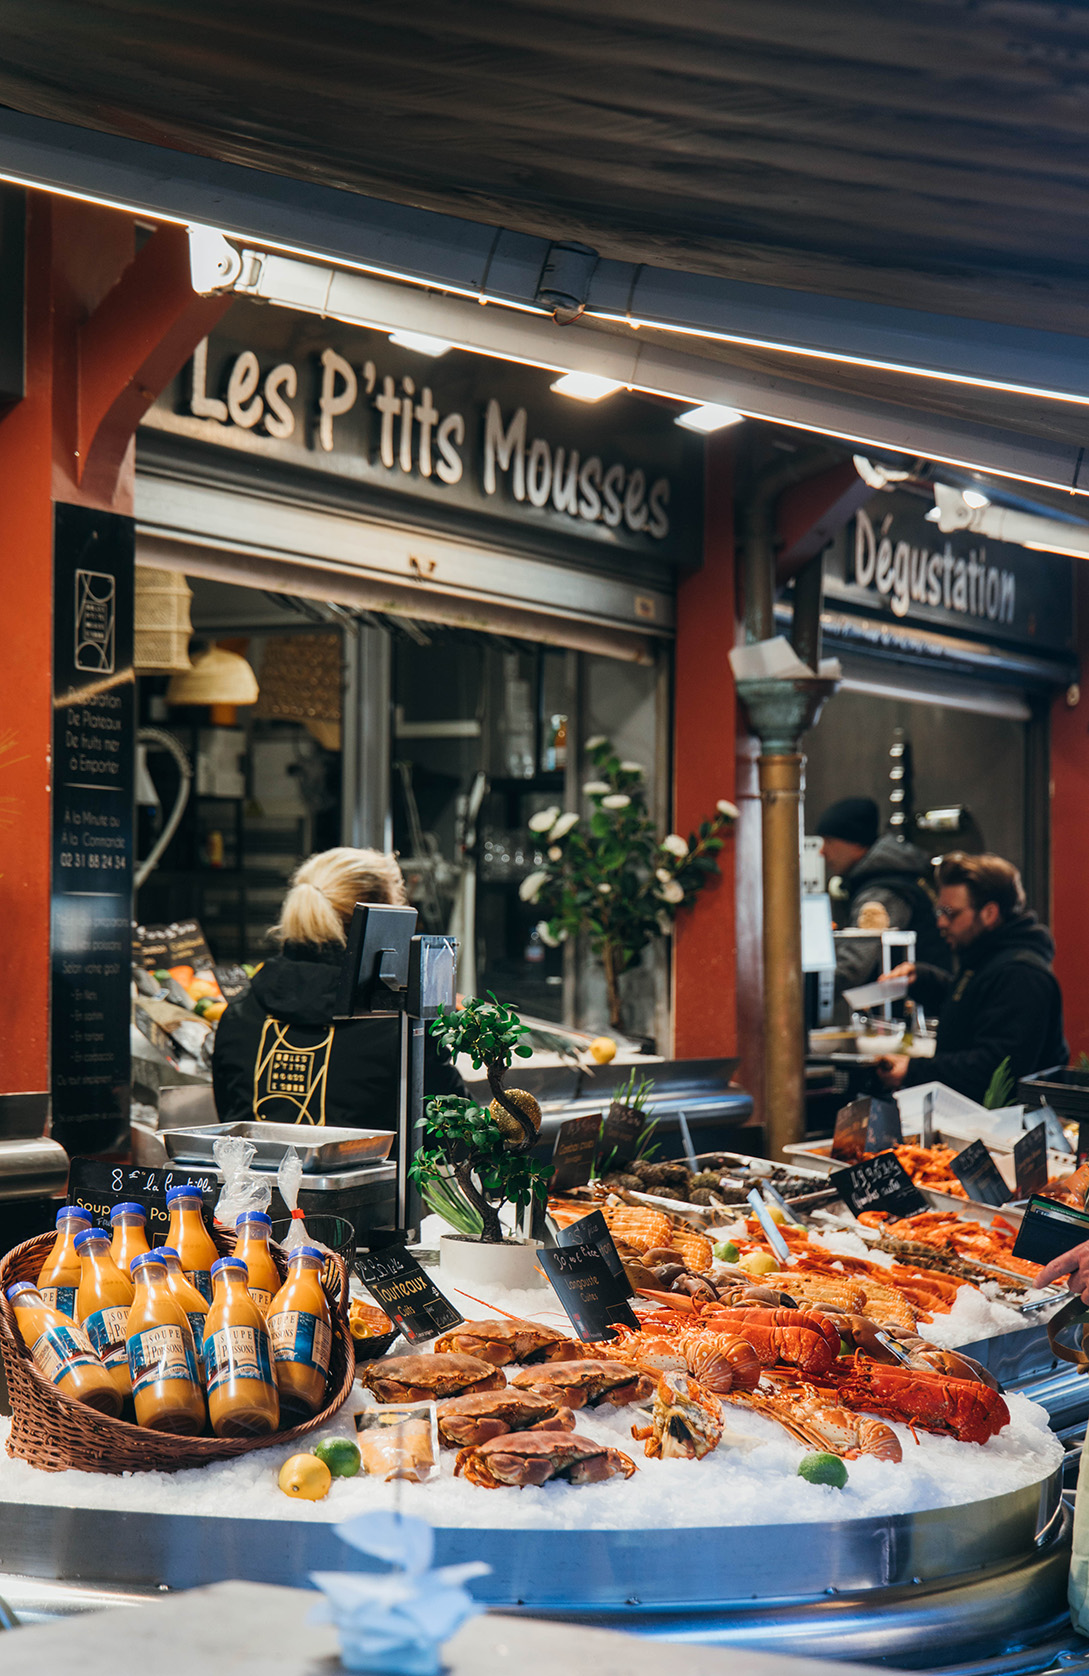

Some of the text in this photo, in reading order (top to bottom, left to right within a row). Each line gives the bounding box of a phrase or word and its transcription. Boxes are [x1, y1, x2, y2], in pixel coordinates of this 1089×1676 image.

[191, 335, 670, 540] Les P'tits Mousses
[855, 507, 1016, 625] Dégustation
[372, 1276, 428, 1304] Tourteaux
[220, 1330, 253, 1343] SUPE
